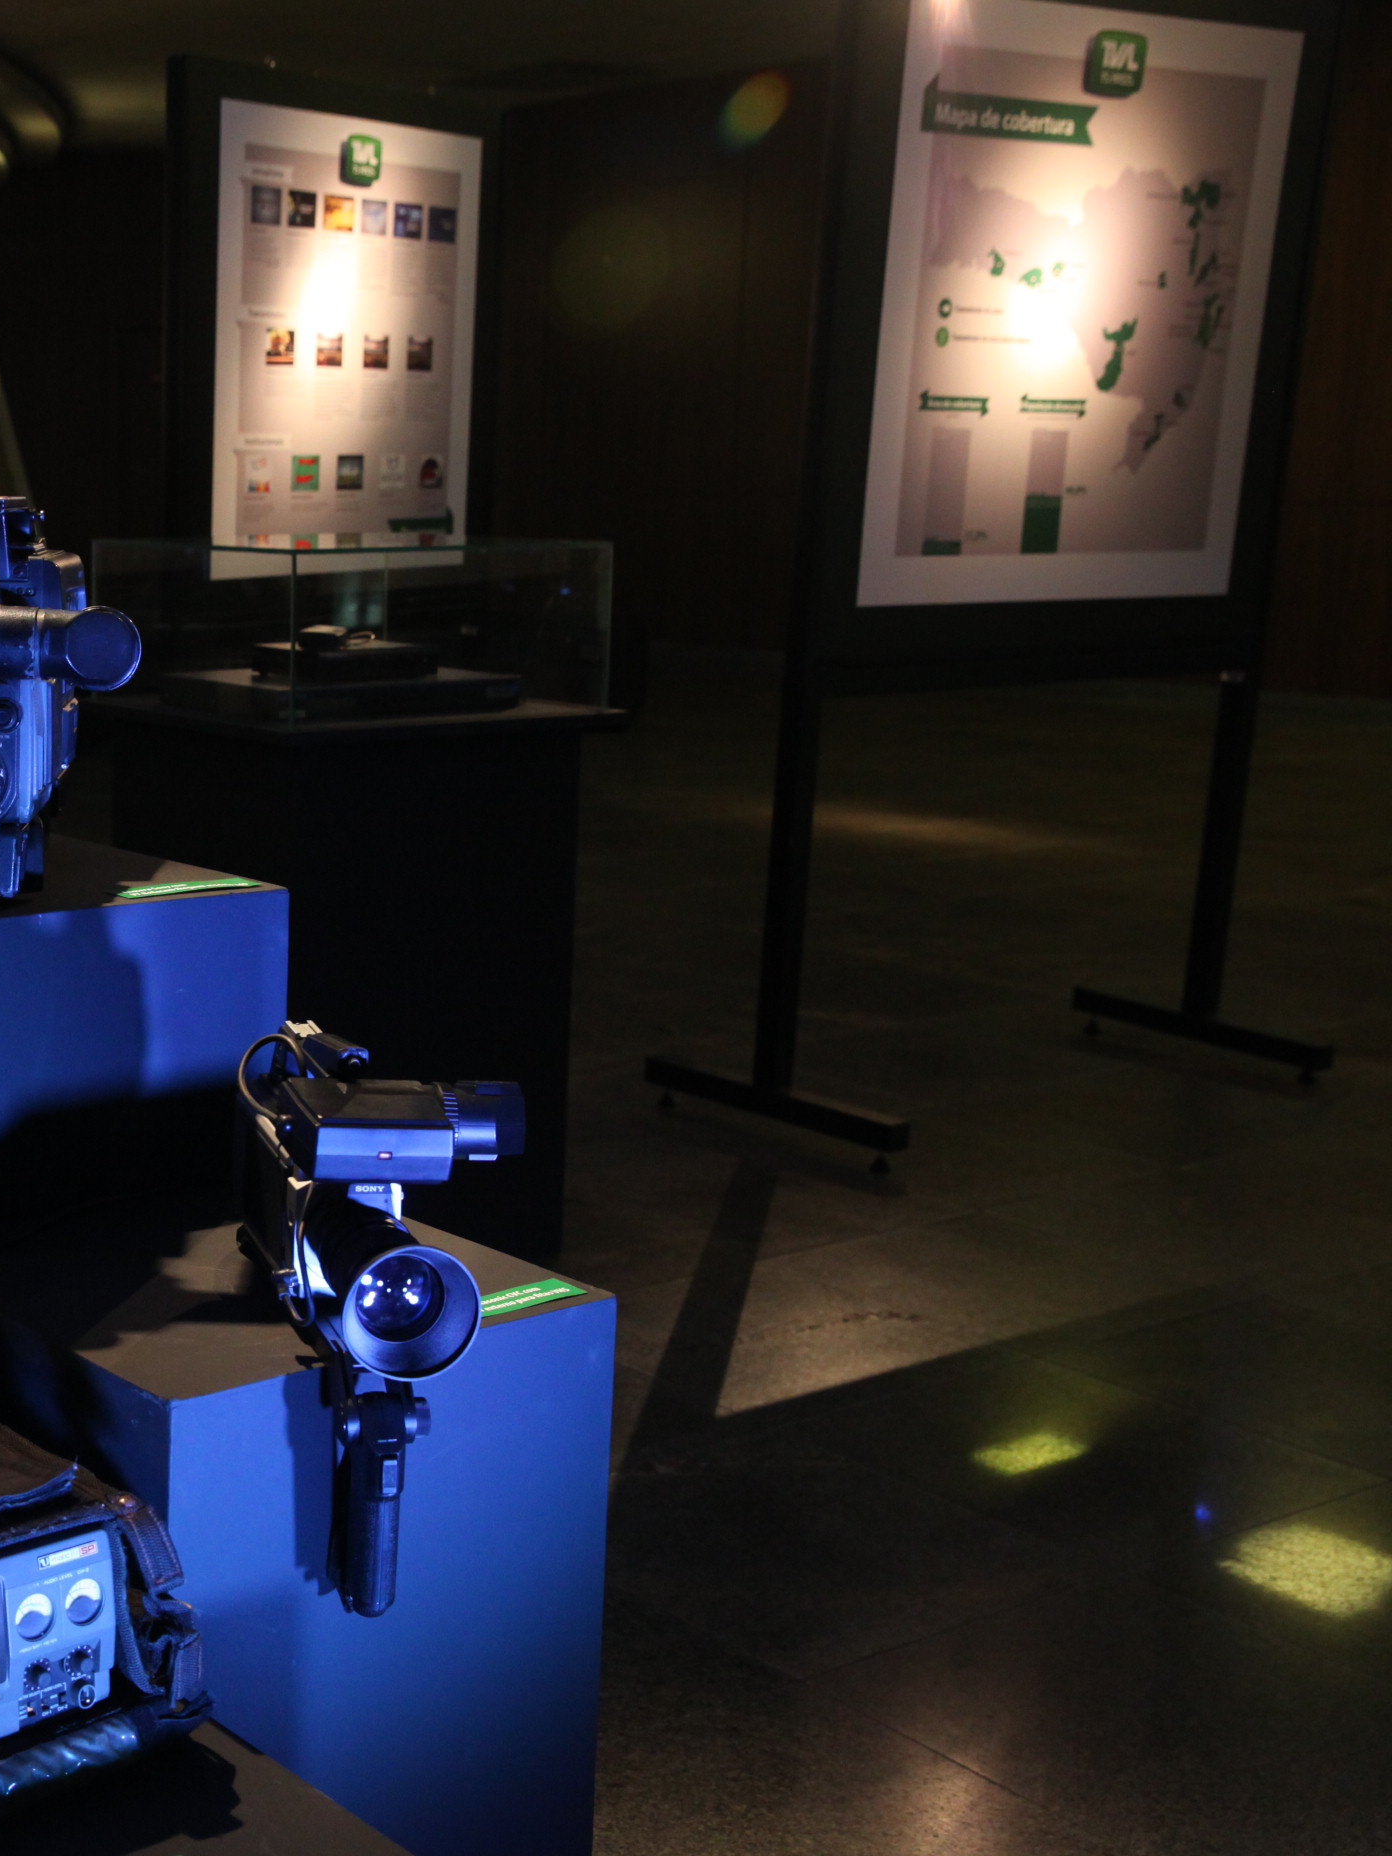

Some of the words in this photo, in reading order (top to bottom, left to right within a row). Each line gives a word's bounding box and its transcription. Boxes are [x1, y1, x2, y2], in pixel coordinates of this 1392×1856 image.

[934, 102, 978, 130] Mapa
[980, 105, 1000, 129] de
[1002, 110, 1076, 137] cobertura
[354, 1185, 385, 1193] SONY
[80, 1543, 96, 1555] SP
